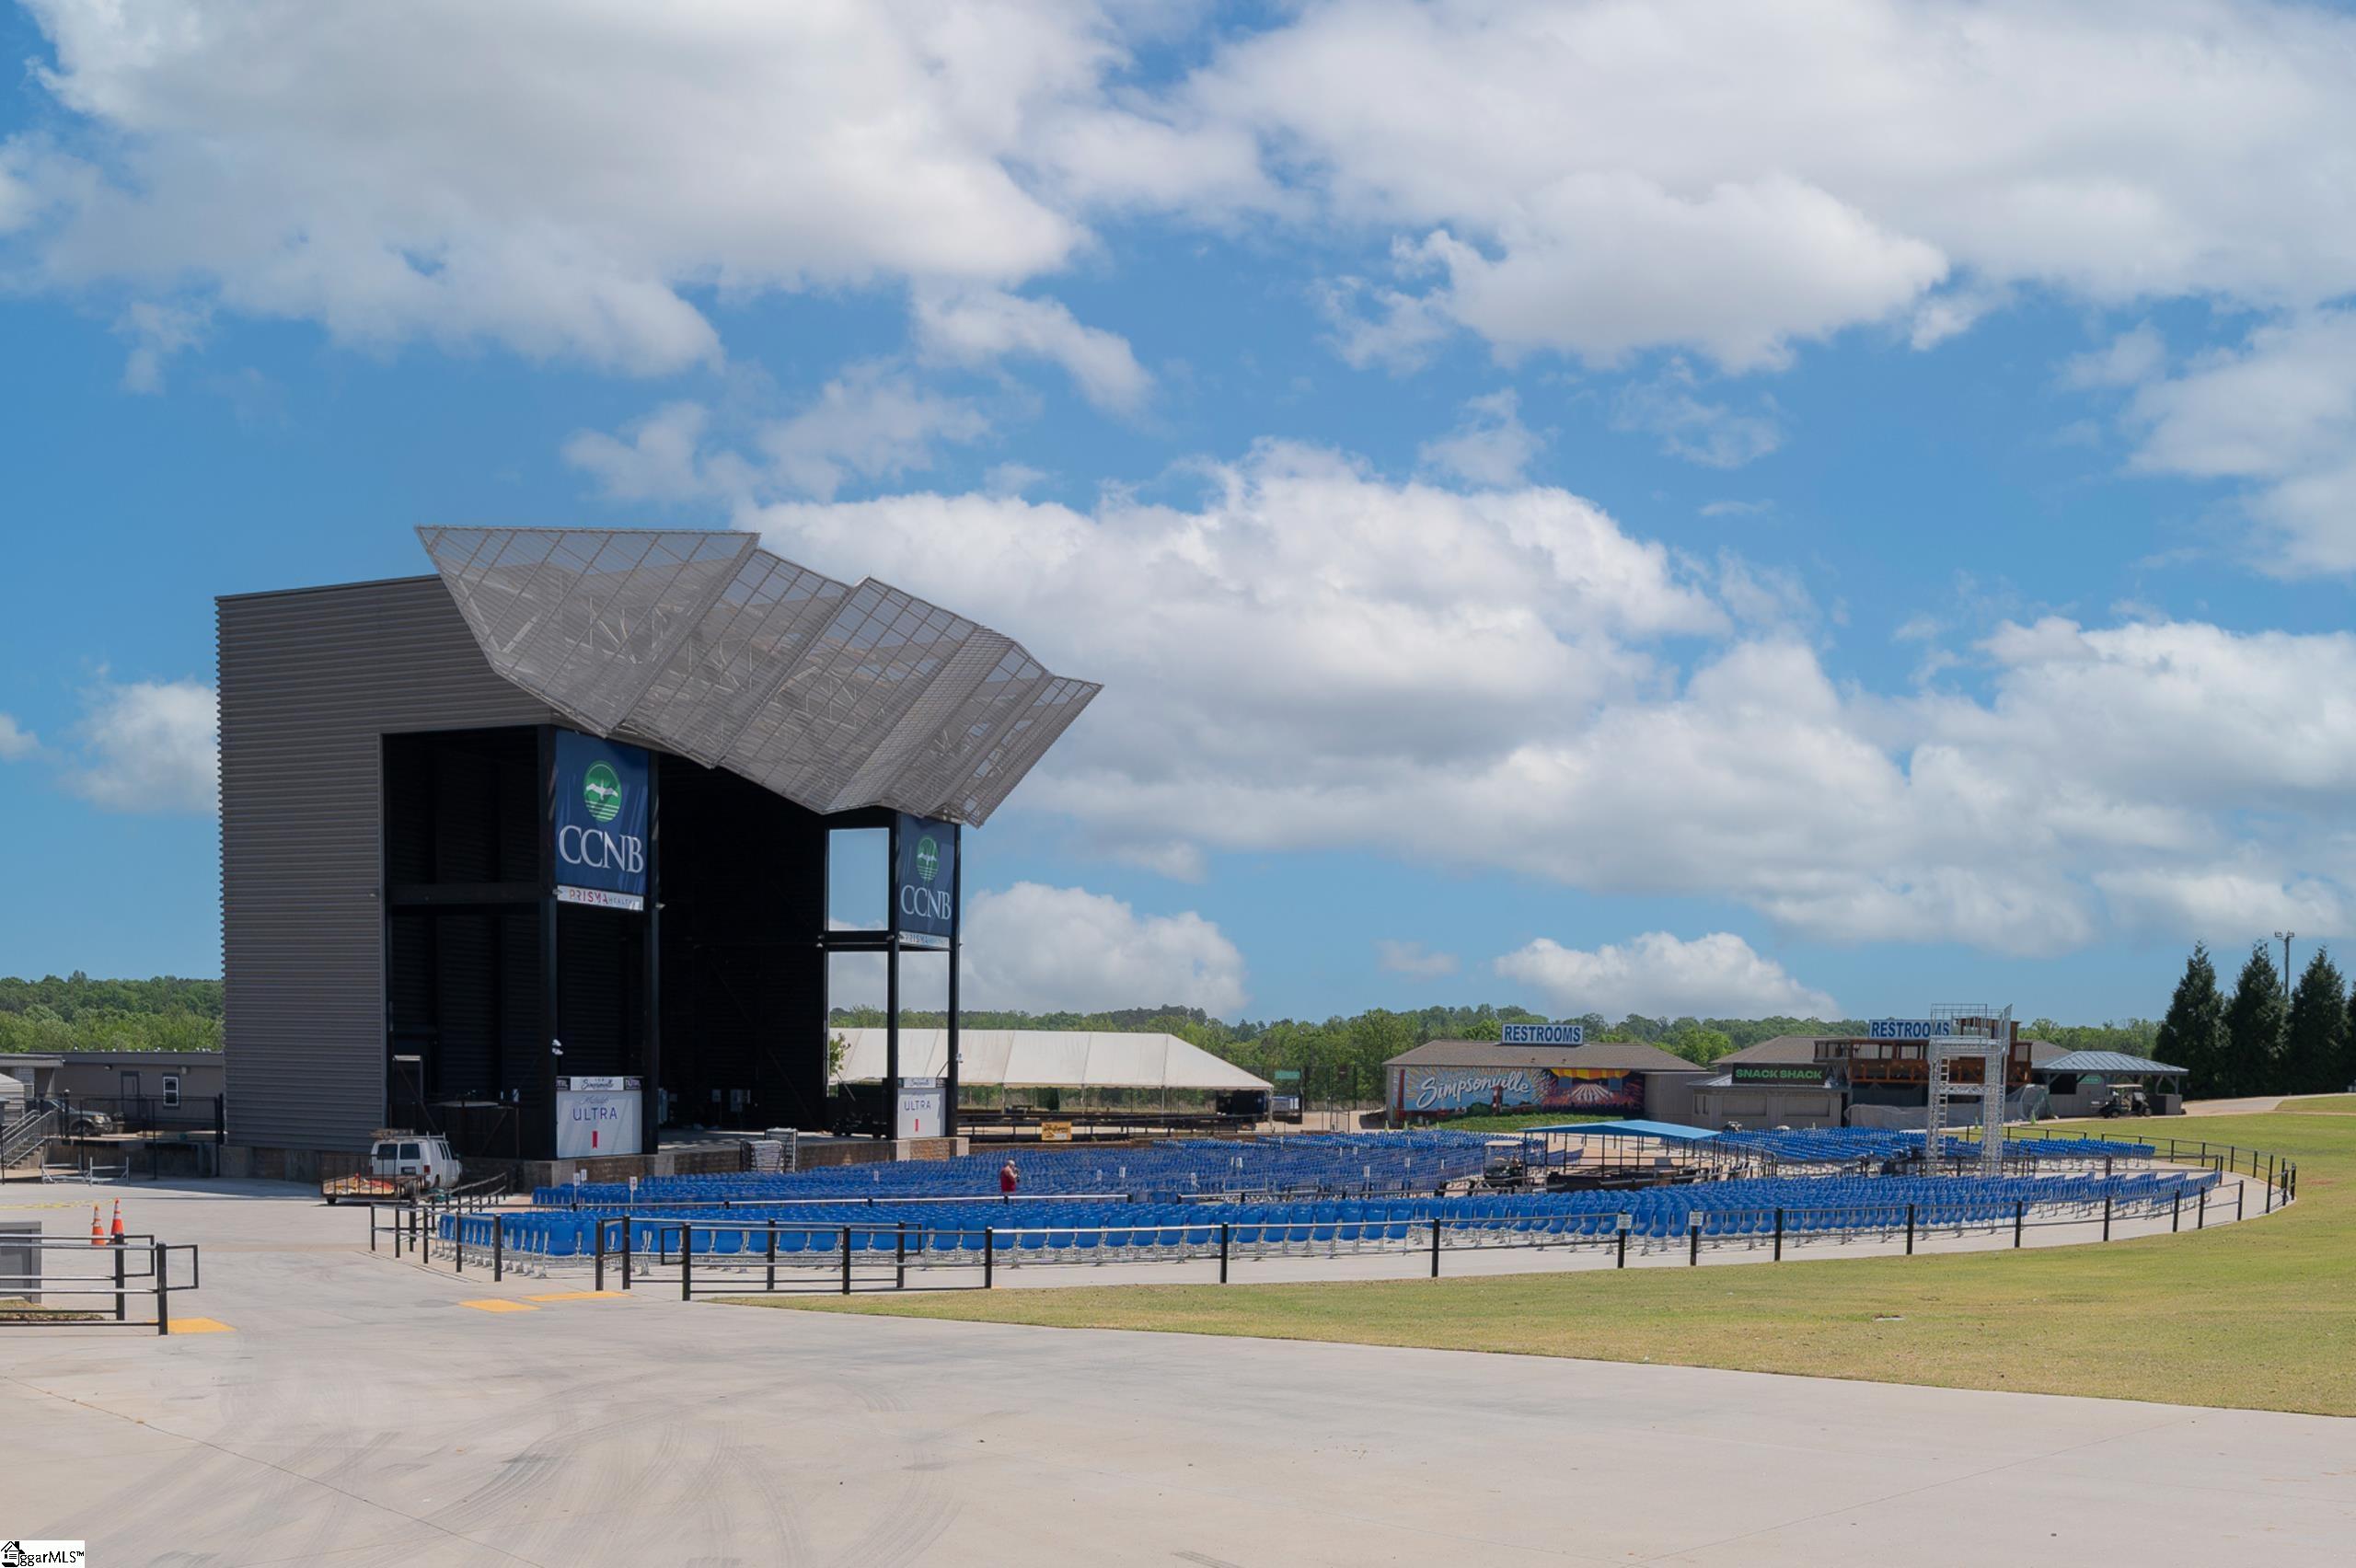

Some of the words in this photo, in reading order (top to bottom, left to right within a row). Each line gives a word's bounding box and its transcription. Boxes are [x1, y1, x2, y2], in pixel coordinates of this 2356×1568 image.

[559, 825, 644, 873] CCNB
[570, 889, 608, 905] PRISMA
[901, 885, 952, 920] CCNB
[1505, 1026, 1581, 1042] RESTROOMS
[1736, 1068, 1778, 1078] SNACK
[1780, 1069, 1822, 1079] SHACK
[1417, 1071, 1530, 1109] Simpsonville
[572, 1107, 618, 1121] ULTRA
[904, 1101, 931, 1111] ULTRA
